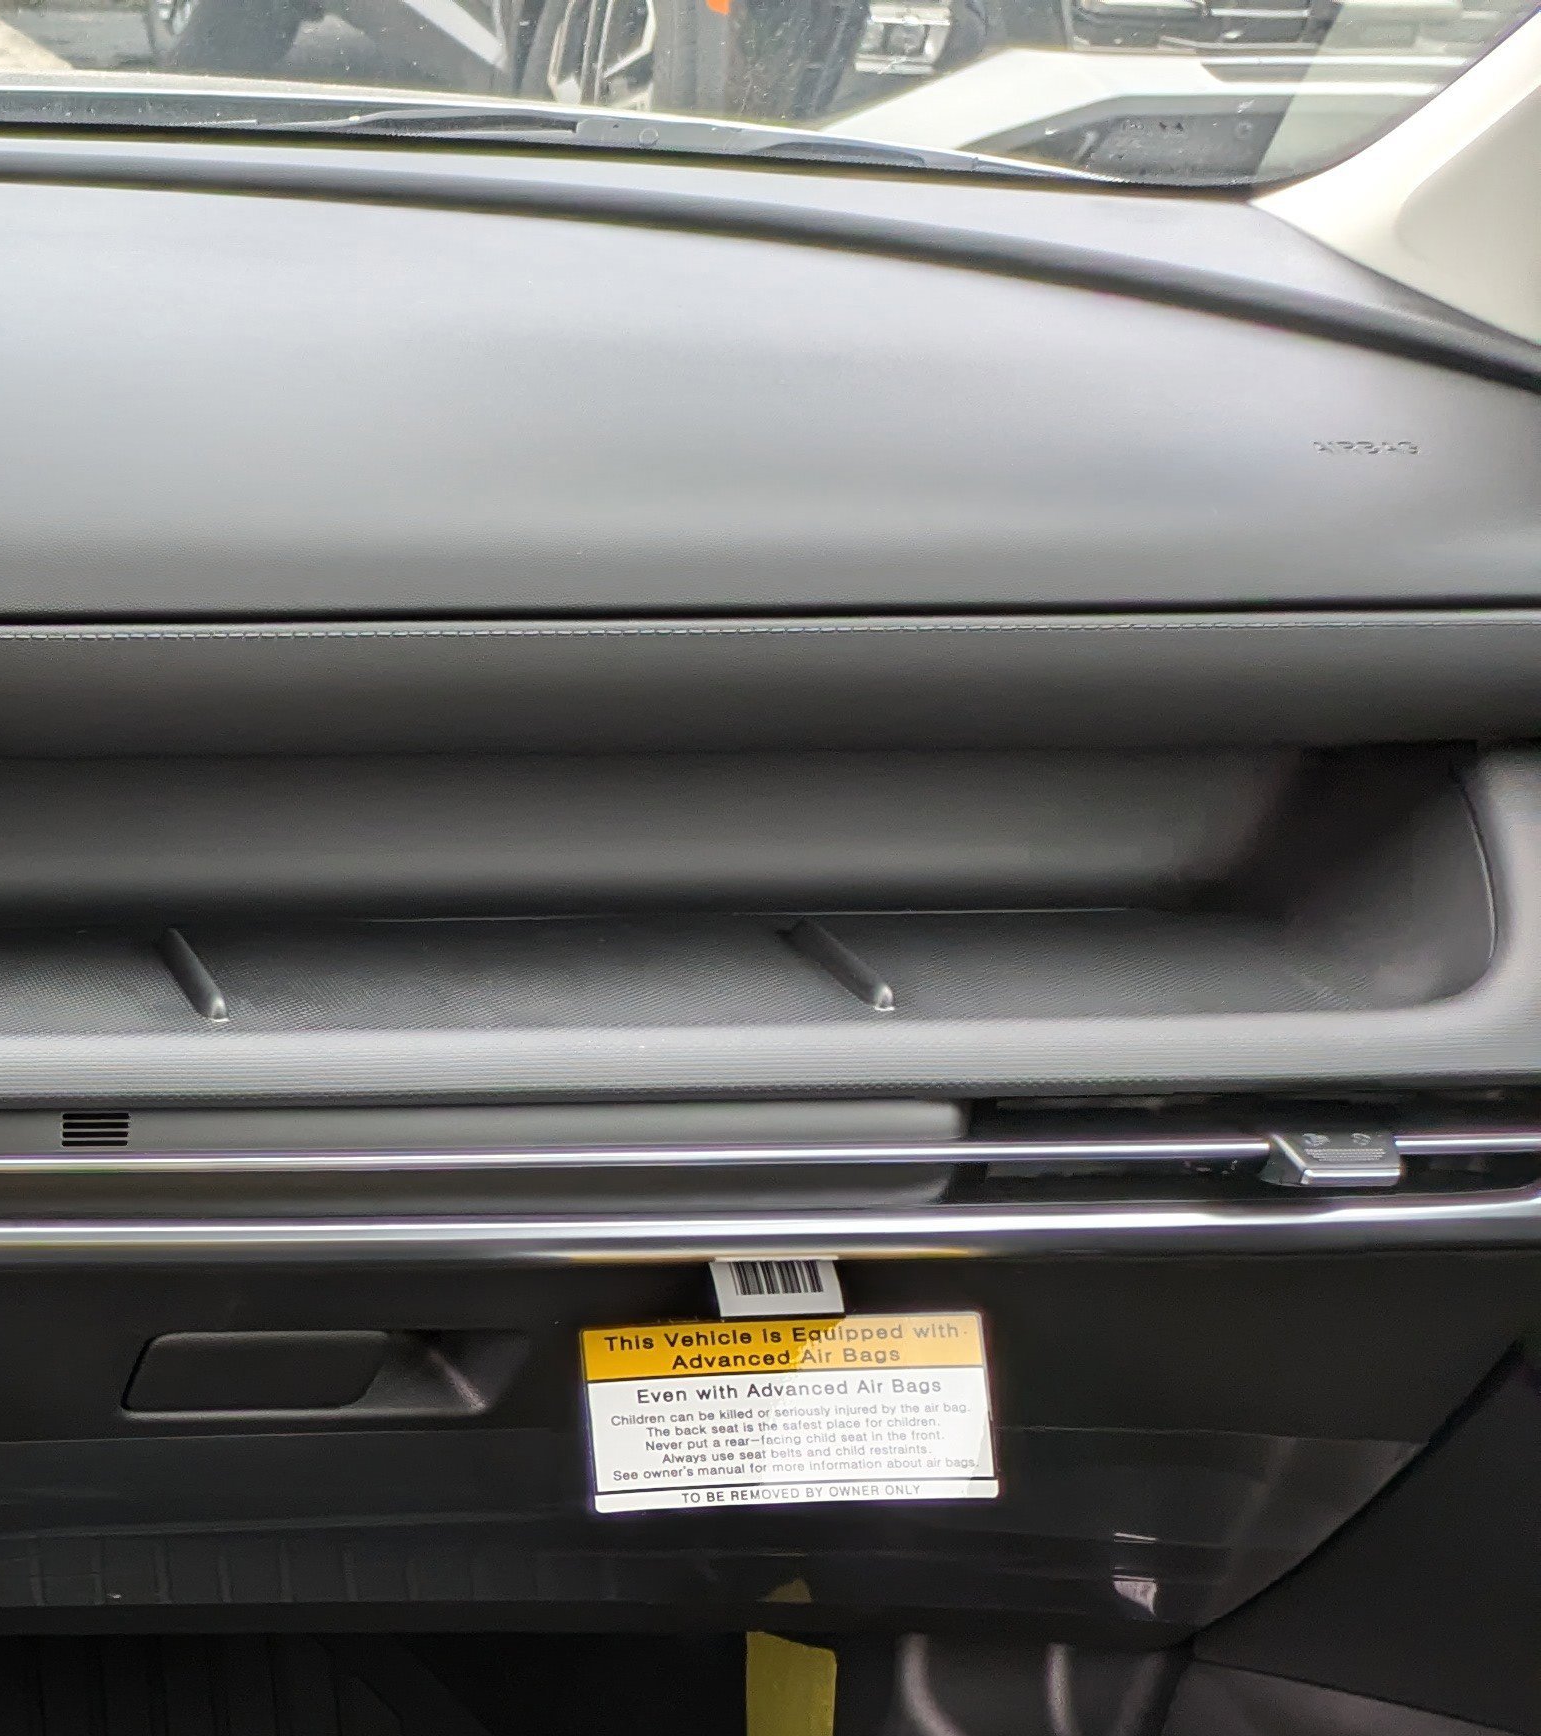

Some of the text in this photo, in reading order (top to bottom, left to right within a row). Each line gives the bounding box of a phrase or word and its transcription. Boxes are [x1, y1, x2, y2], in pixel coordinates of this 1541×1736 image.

[604, 1323, 959, 1351] This Vehicle is Equipped with
[672, 1348, 901, 1370] Advanced Air Bags
[637, 1378, 942, 1404] Even with Advanced Air Bags
[611, 1401, 970, 1426] Children can be killed or seriously injured by the air bag.
[646, 1416, 940, 1438] The back seat is the safest place for children.
[645, 1430, 945, 1451] Never put a rear-facing child seat in the front.
[662, 1444, 932, 1464] Always use seat belts and child restraints.
[613, 1457, 979, 1481] See owner's manual for more information about air bags.
[681, 1484, 921, 1503] TO BE REMOVED BY OWNER ONLY
